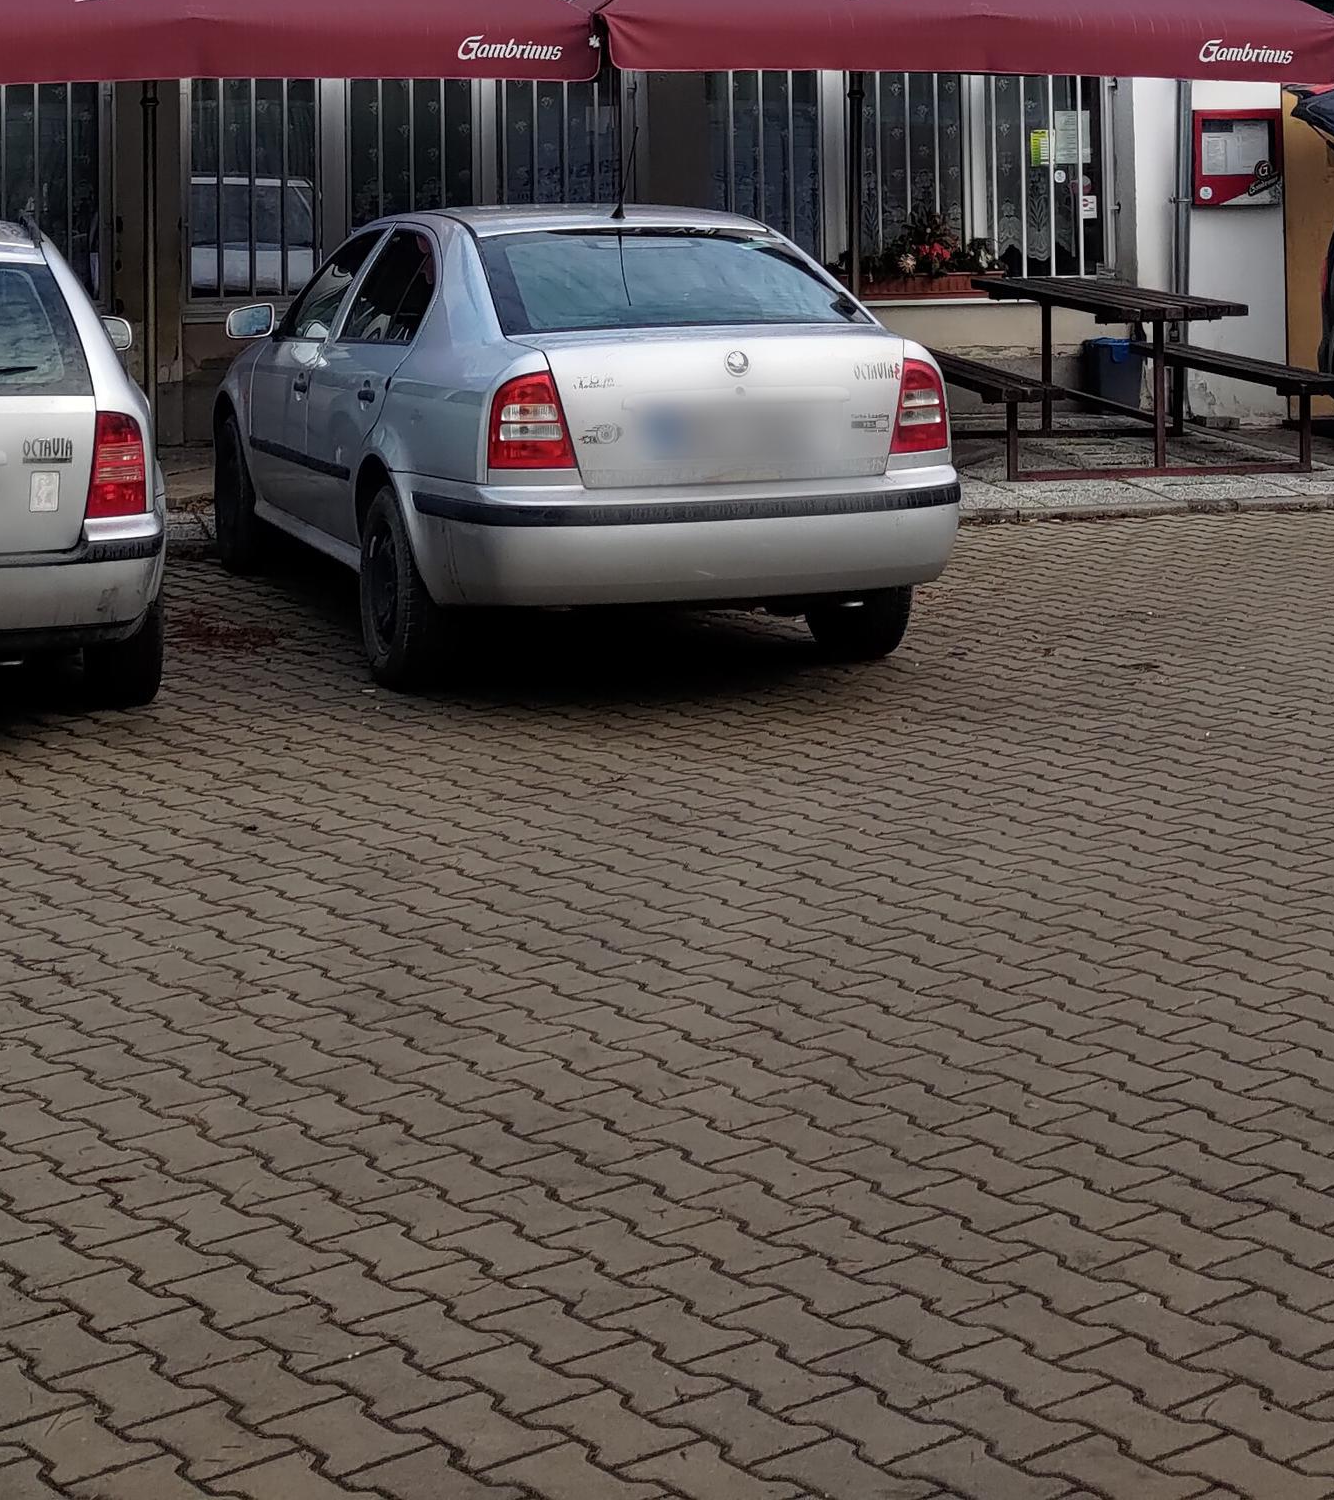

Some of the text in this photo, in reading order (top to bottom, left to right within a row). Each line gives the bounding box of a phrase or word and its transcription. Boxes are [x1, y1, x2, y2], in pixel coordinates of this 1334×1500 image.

[457, 34, 563, 60] Gambrinus
[1198, 39, 1294, 64] Gambrinus
[23, 437, 72, 457] OCTAVIA
